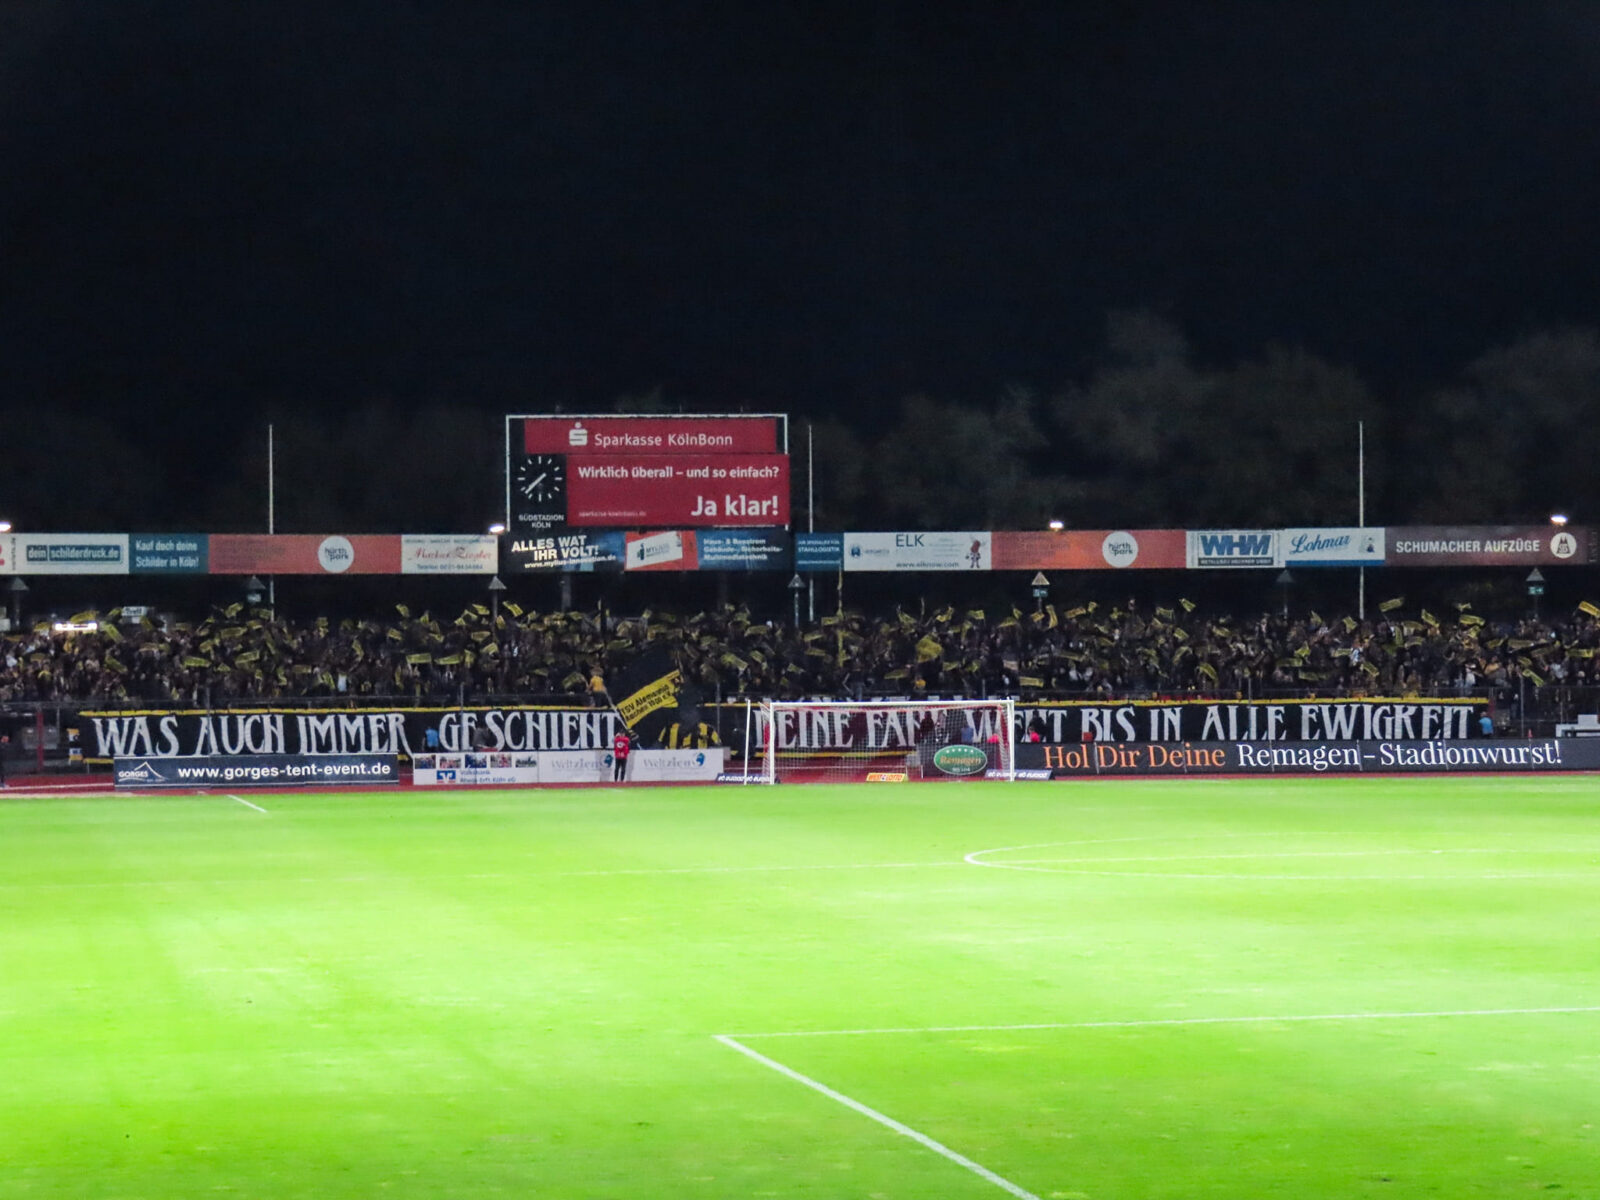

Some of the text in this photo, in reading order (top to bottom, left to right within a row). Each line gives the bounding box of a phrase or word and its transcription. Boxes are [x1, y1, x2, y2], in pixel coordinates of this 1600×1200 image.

[594, 433, 662, 449] Sparkasse
[668, 433, 733, 446] KölnBonn
[578, 466, 629, 478] Wirklich
[631, 466, 673, 478] überall
[686, 466, 709, 478] und
[712, 469, 726, 478] so
[729, 466, 780, 478] einfach?
[691, 495, 779, 517] Ja klar!
[518, 513, 565, 521] SÜDSTADION
[531, 521, 551, 529] KÖLN
[135, 540, 198, 551] Kauf doch deine
[511, 535, 587, 552] ALLES WAT
[895, 534, 926, 548] ELK
[1200, 534, 1272, 556] WHM
[1395, 538, 1541, 553] SCHUMACHER AUFZÜGE
[51, 546, 119, 559] schilderdruck.de
[534, 545, 599, 561] IHR VOLT!
[135, 557, 168, 568] Schilder
[170, 557, 177, 567] in
[621, 702, 635, 715] TSV
[1149, 706, 1183, 742] IN
[1201, 704, 1287, 741] ALLE
[1300, 703, 1474, 740] EWIGKEIT
[92, 711, 620, 759] WAS AUCH IMMER GESCHIEHT
[1043, 743, 1090, 769] Hol
[1096, 744, 1140, 768] Dir
[1147, 742, 1226, 768] Deine
[1236, 743, 1360, 771] Remagen
[1380, 739, 1563, 766] Stadionwurst!
[118, 770, 149, 778] GORGES
[177, 761, 391, 781] www.gorges-tent-event.de
